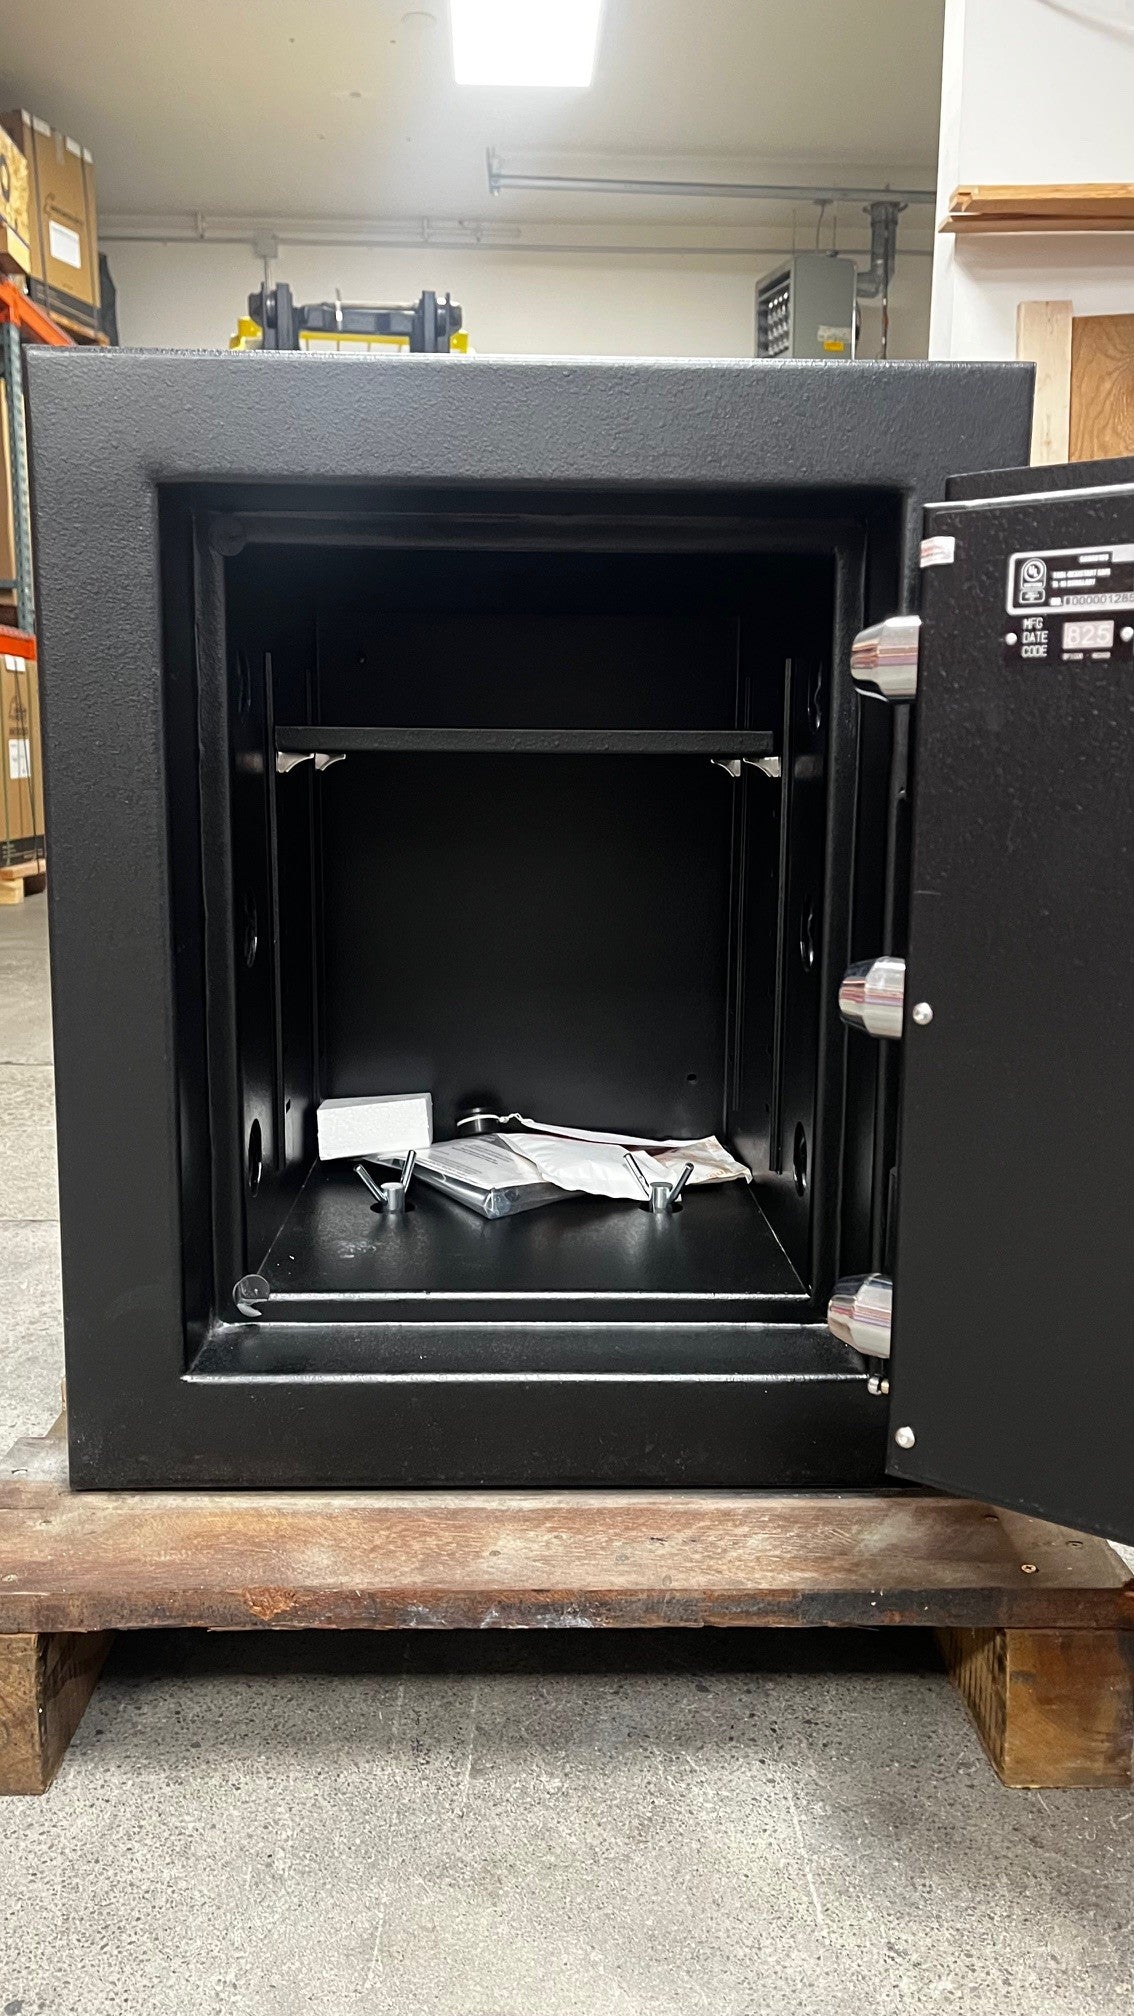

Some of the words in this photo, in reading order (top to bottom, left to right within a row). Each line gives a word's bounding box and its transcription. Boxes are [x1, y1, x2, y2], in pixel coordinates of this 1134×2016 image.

[1023, 617, 1043, 629] MFG
[1022, 630, 1048, 643] DATE
[1069, 624, 1110, 645] 825
[1021, 645, 1048, 658] CODE
